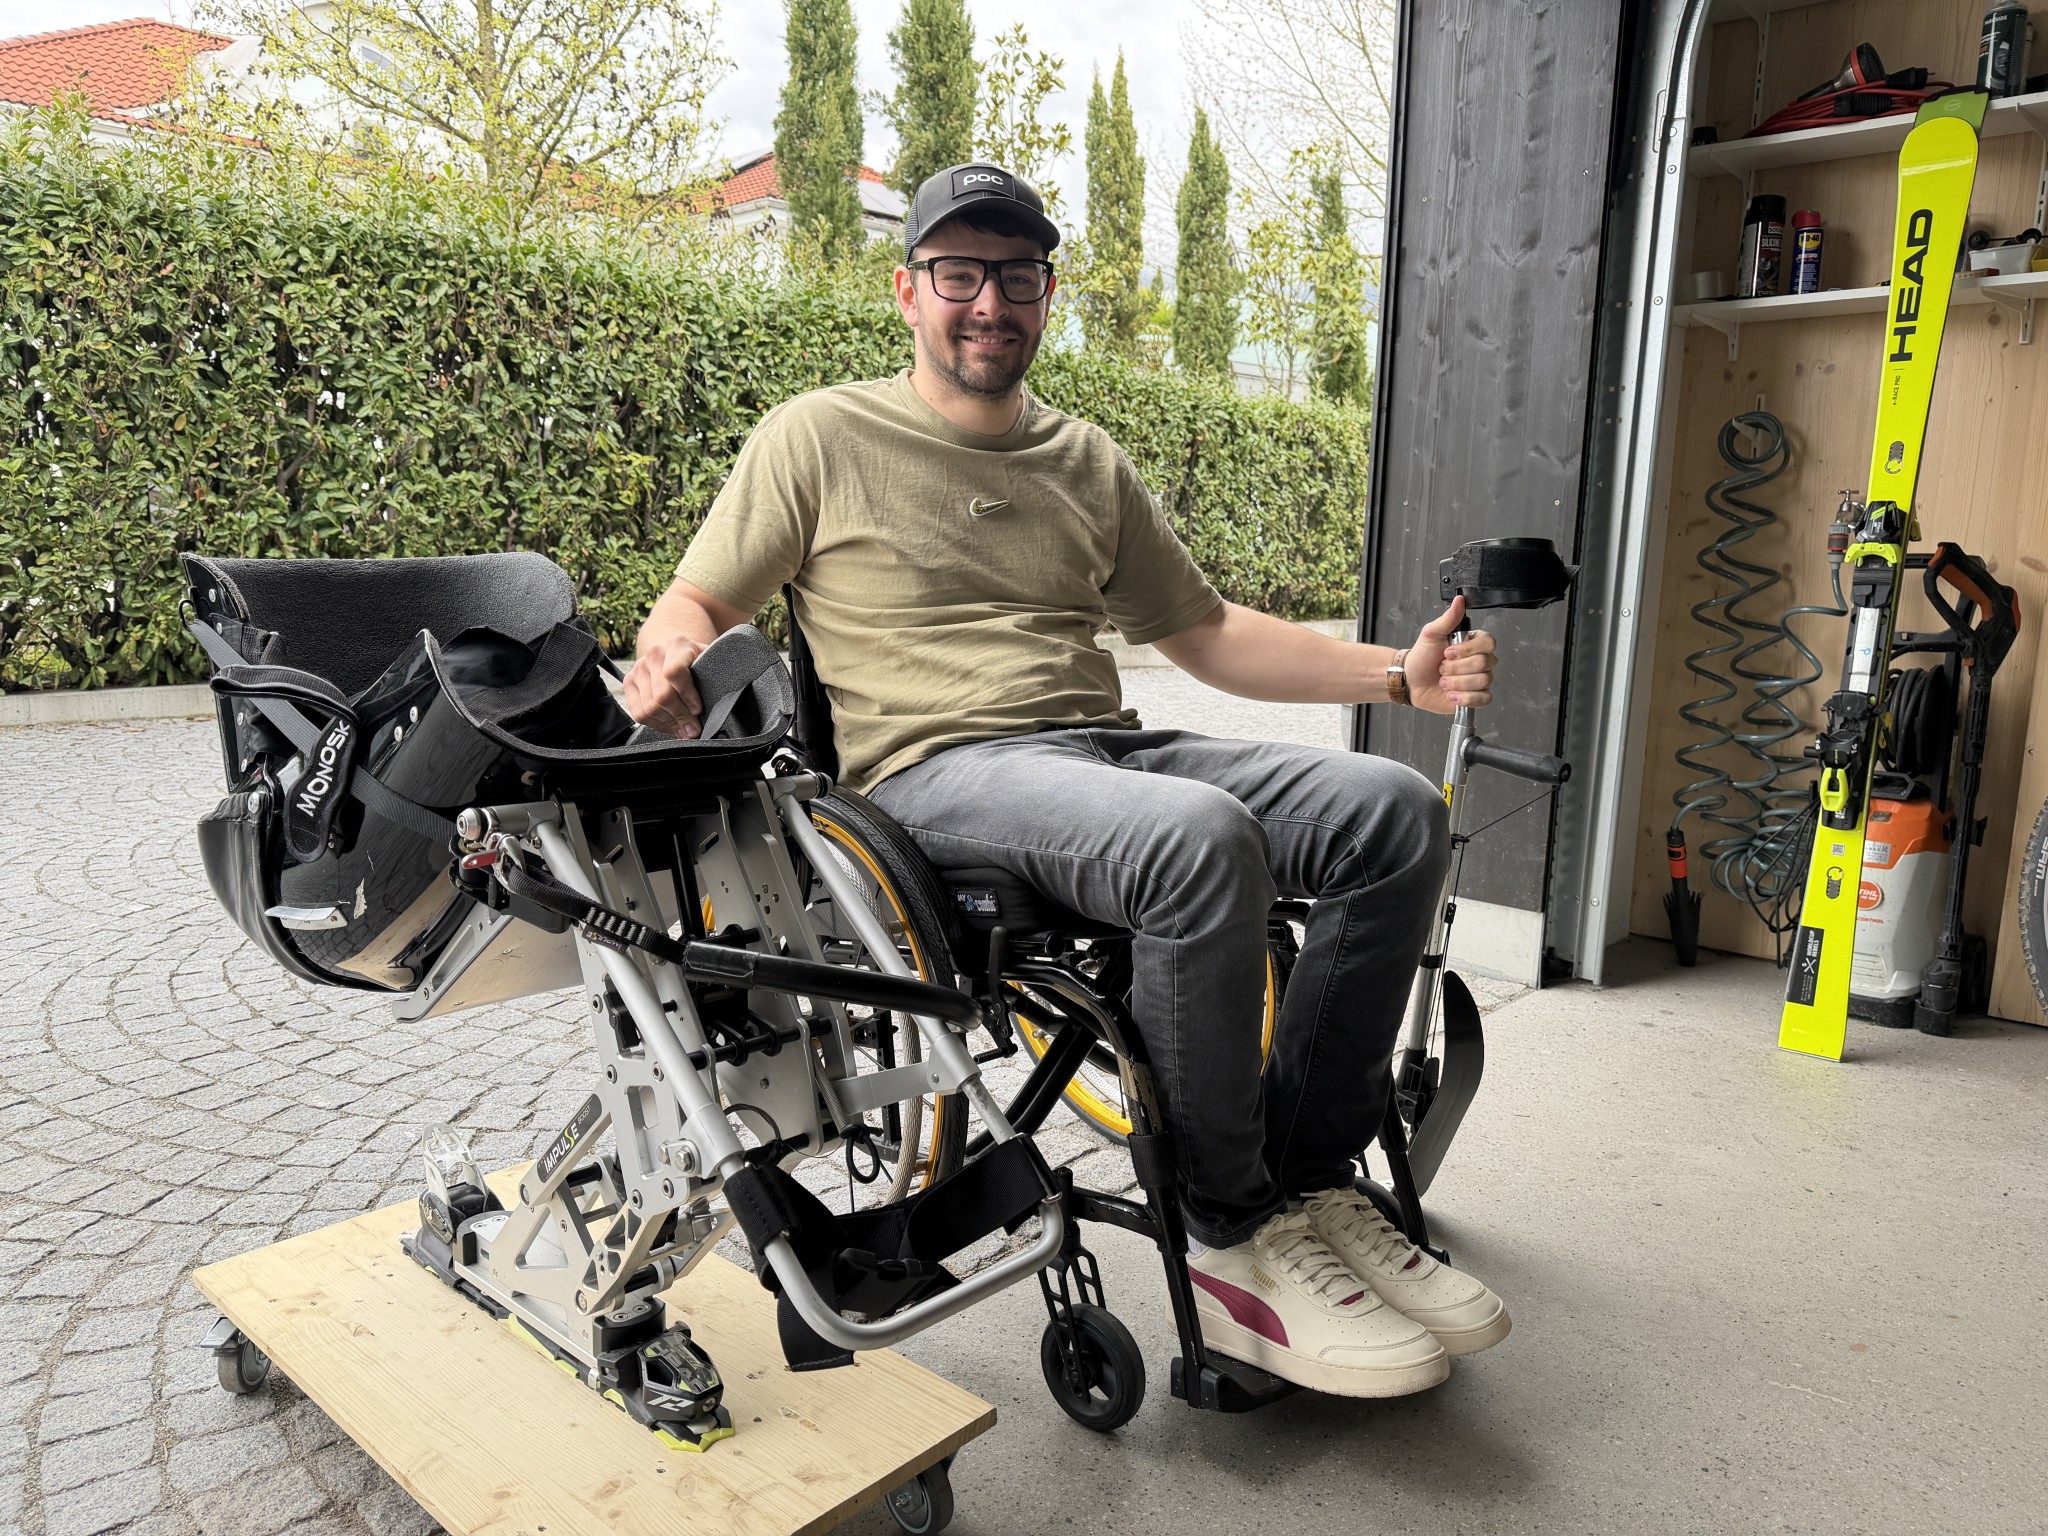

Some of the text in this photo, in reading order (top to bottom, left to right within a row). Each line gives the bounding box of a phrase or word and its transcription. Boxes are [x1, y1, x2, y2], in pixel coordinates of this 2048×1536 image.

[1889, 208, 1933, 363] HEAD
[1859, 888, 1878, 898] TIHL
[543, 1122, 580, 1174] IMPULSE
